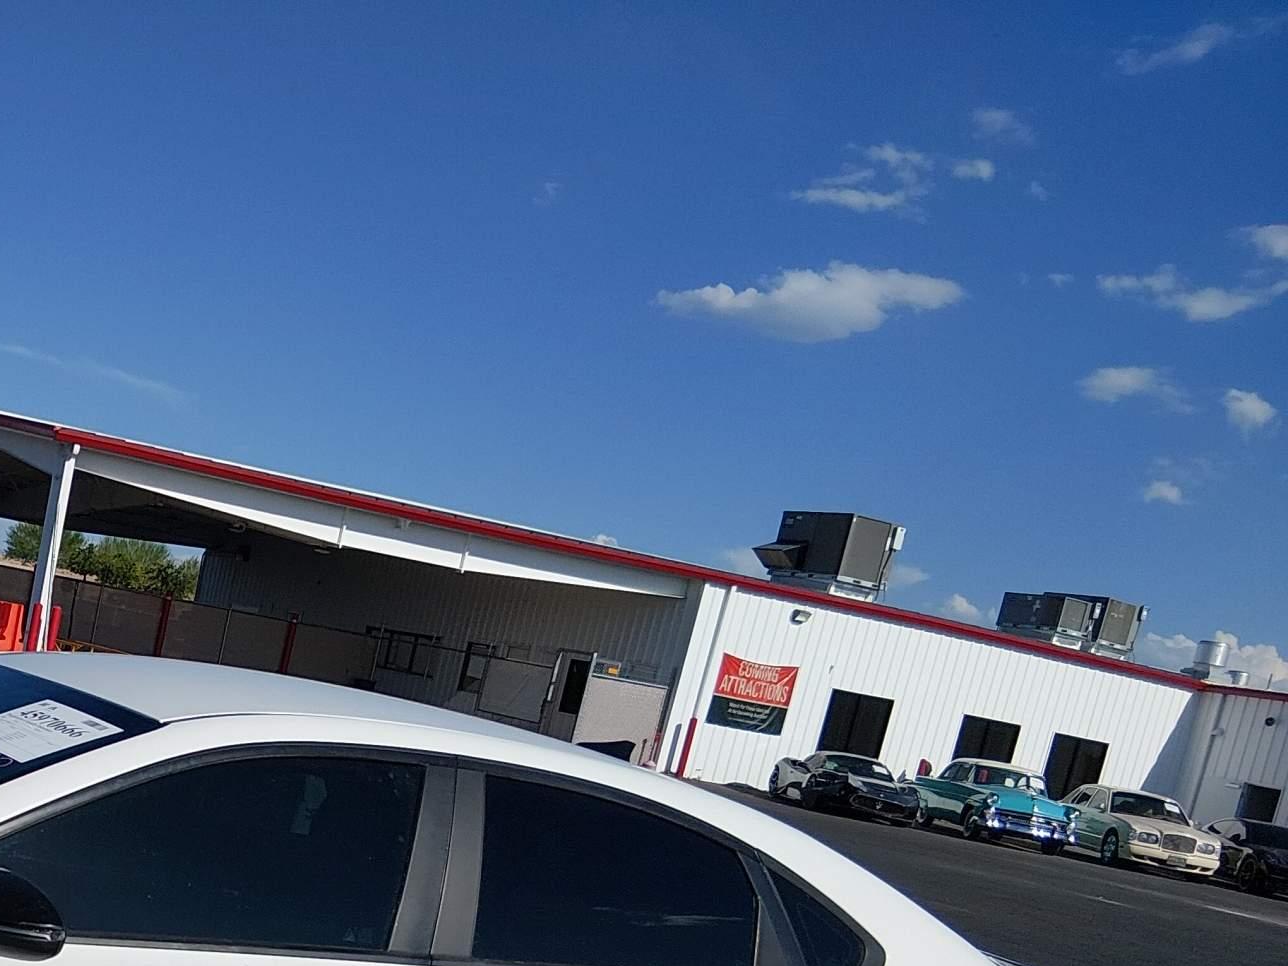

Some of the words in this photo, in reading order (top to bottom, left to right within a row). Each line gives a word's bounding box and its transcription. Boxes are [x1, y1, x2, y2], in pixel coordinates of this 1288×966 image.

[738, 661, 781, 683] COMING
[718, 674, 789, 703] ATTRACTIONS
[20, 710, 90, 738] 45970666
